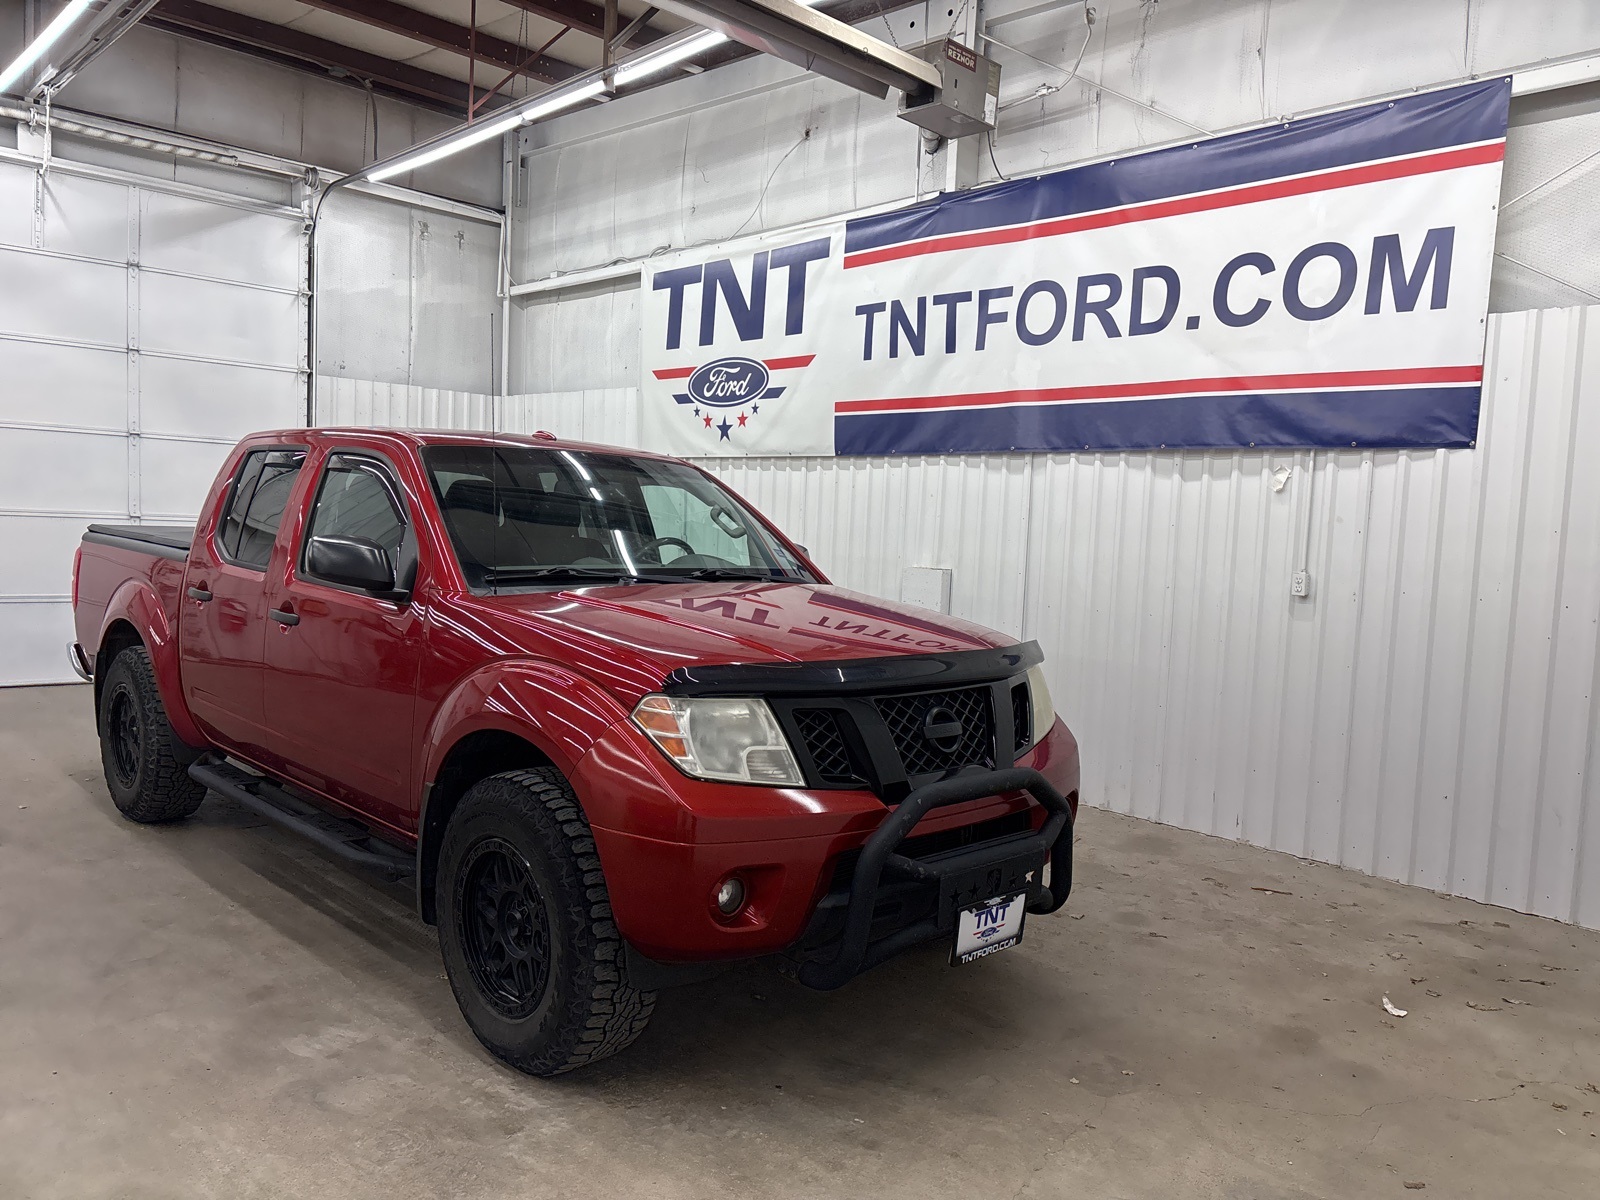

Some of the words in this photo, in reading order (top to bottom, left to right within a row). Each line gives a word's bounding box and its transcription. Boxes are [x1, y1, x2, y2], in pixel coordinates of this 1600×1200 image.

[947, 48, 975, 69] REZNOR
[653, 236, 831, 350] TNT
[854, 225, 1456, 361] TNTFORD.COM
[703, 366, 752, 397] Ford
[974, 903, 1011, 929] TNT
[961, 937, 1017, 964] TNTFORD.COM
